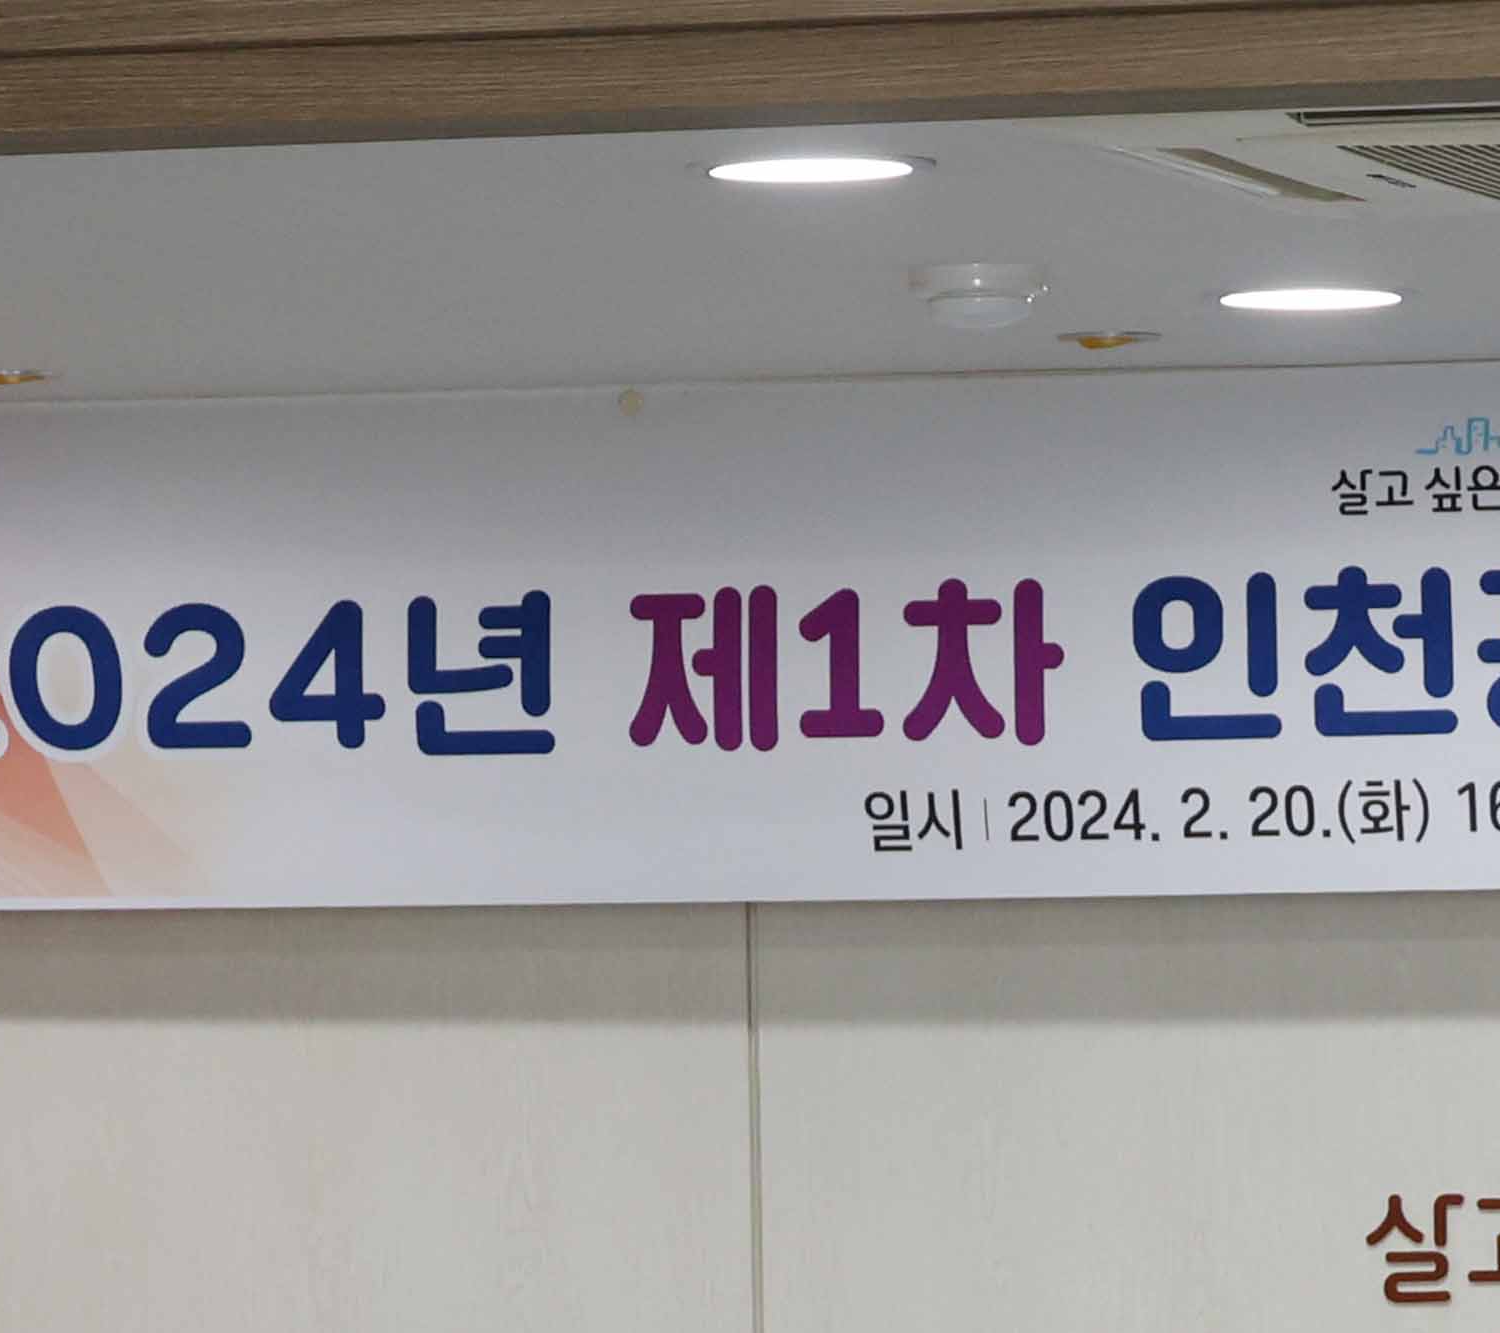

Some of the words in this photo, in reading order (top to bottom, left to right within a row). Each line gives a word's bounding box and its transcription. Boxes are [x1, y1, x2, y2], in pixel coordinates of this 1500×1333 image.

[1332, 467, 1413, 516] 살고
[629, 578, 1065, 753] 제1차
[864, 788, 963, 852] 일시
[1008, 789, 1159, 843] 2024.
[1181, 787, 1228, 841] 2.
[1249, 778, 1430, 845] 20.(화)
